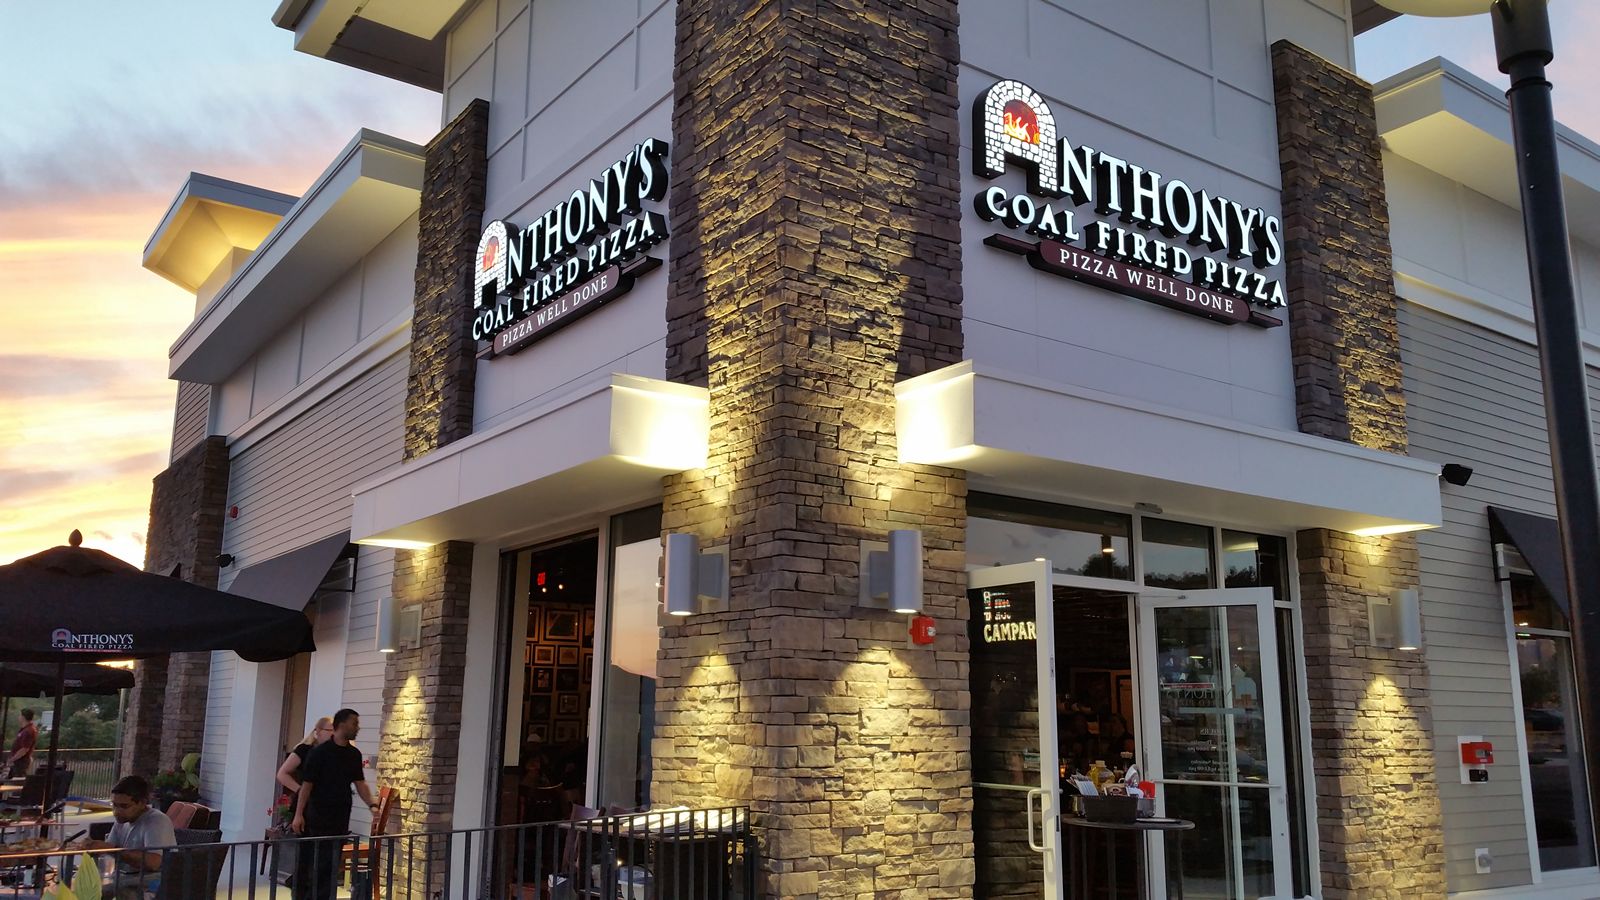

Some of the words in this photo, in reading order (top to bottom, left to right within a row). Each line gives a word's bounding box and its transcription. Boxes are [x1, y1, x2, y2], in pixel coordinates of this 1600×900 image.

[474, 138, 654, 308] ANTHONY'S
[985, 79, 1281, 267] ANTHONY'S
[472, 298, 514, 341] COAL
[522, 257, 580, 311] FIRED
[587, 211, 654, 272] PIZZA
[986, 186, 1080, 241] COAL
[1097, 220, 1192, 275] FIRED
[1203, 256, 1287, 307] PIZZA
[1060, 248, 1118, 279] PIZZA
[1126, 268, 1178, 297] WELL
[1186, 286, 1234, 314] DONE
[502, 322, 533, 347] PIZZA
[537, 304, 568, 326] WELL
[573, 275, 608, 305] DONE
[52, 628, 134, 645] ANTHONY'S
